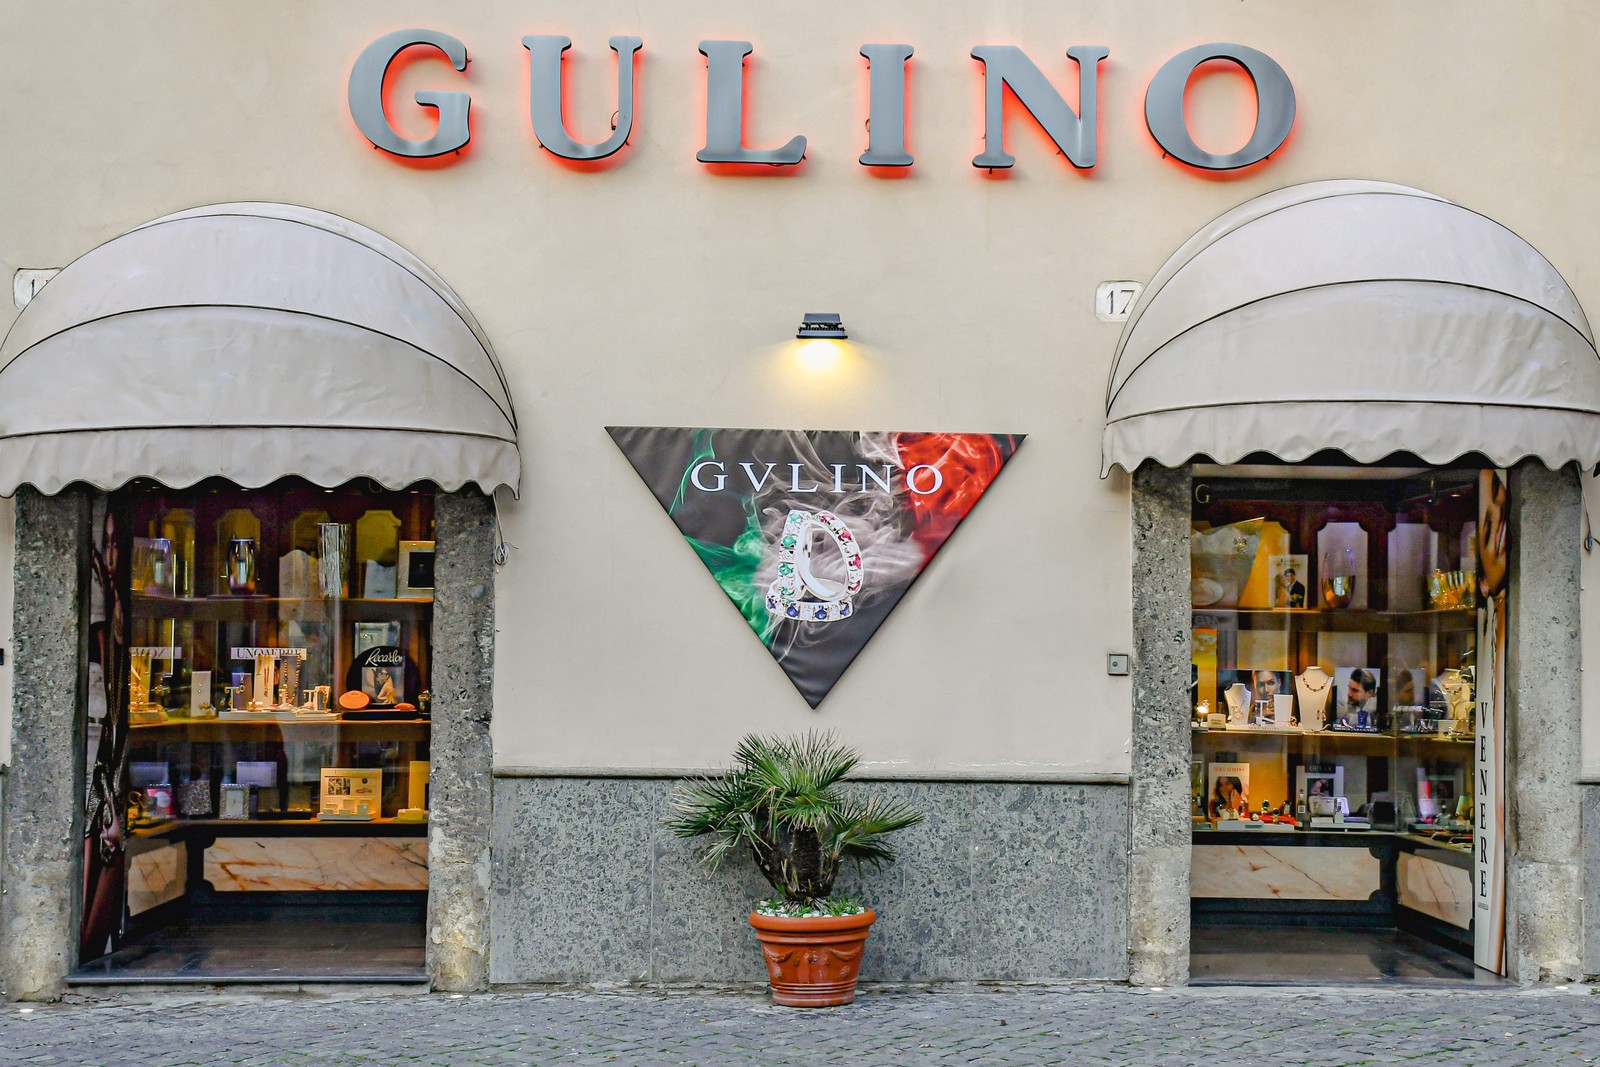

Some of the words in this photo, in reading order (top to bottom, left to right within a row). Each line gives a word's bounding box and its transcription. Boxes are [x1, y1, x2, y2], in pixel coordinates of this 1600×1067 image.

[347, 28, 1296, 170] GULINO
[28, 279, 49, 300] 1
[1106, 289, 1135, 315] 17
[690, 460, 944, 495] GVLINO
[1479, 702, 1488, 897] VENERE
